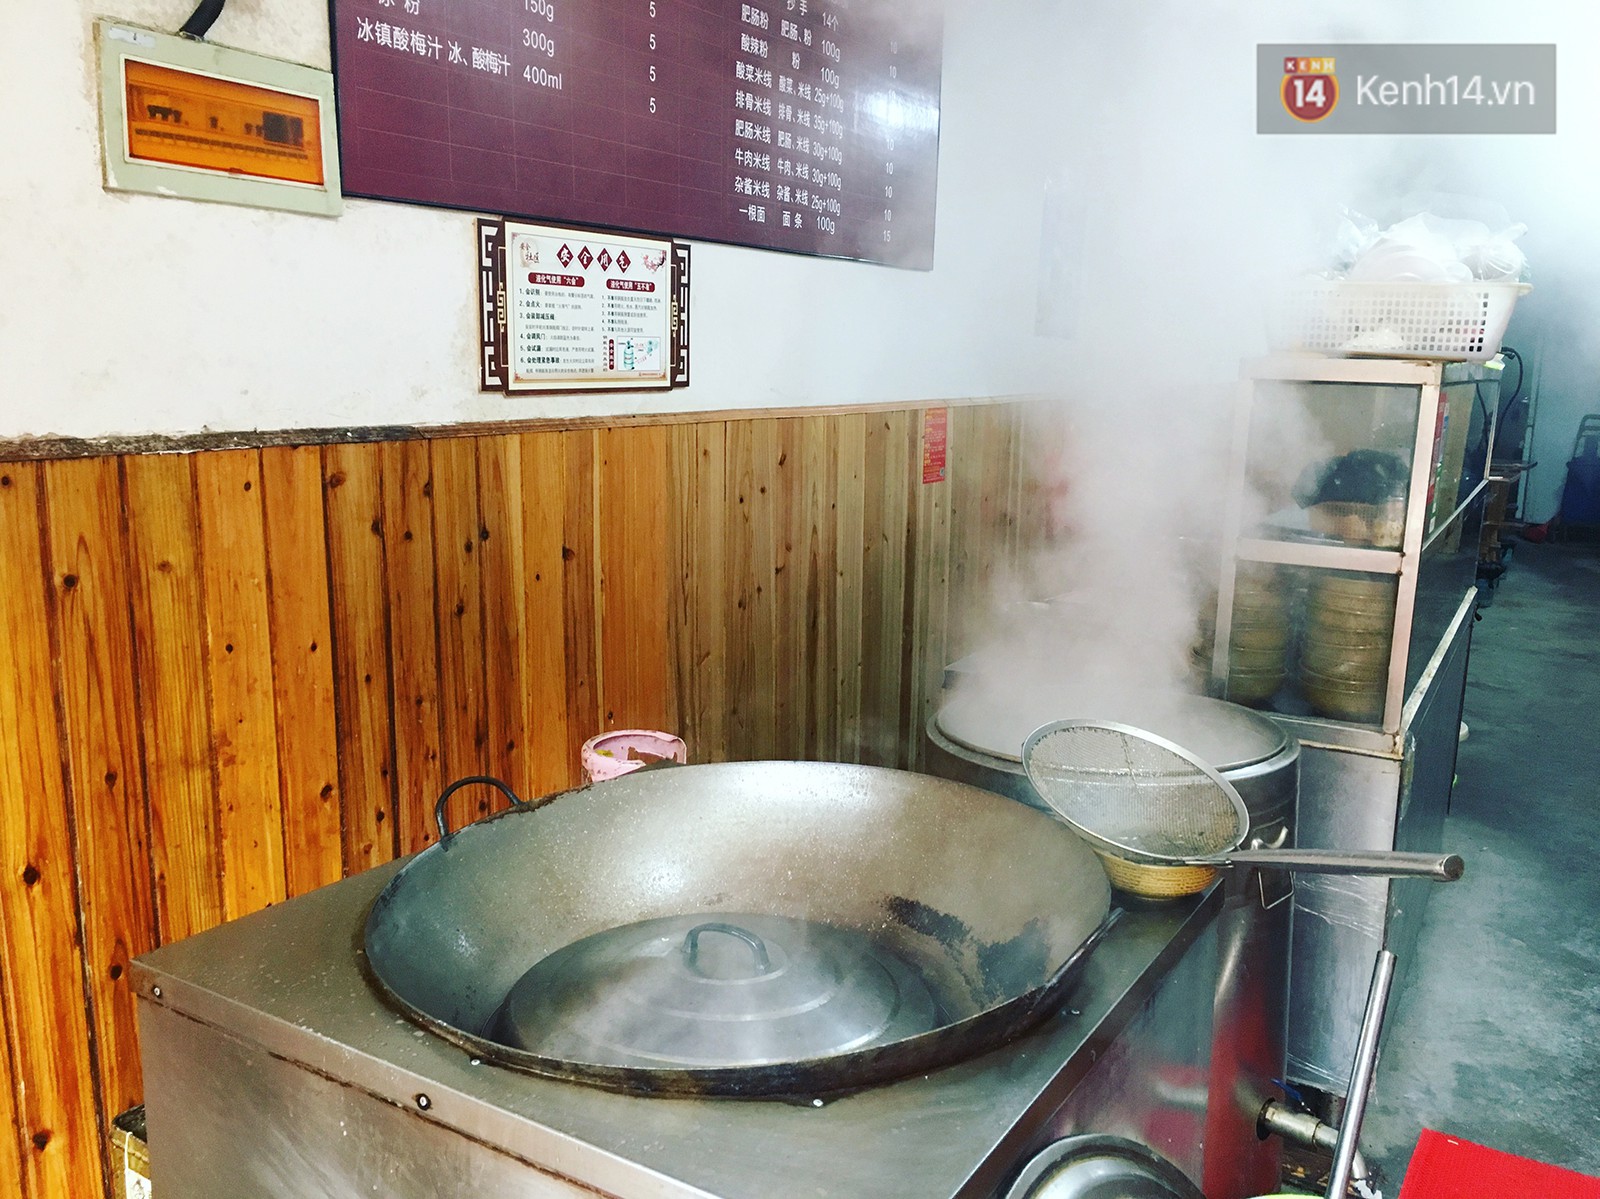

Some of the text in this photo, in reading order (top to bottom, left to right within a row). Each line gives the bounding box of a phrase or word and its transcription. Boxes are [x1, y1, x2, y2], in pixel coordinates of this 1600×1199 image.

[524, 0, 656, 49] 150g 5
[741, 3, 769, 30] 肥肠粉
[821, 39, 841, 62] 100g
[889, 65, 897, 79] 10
[356, 17, 443, 60] 冰镇酸梅汁
[522, 64, 563, 90] 400ml
[649, 97, 656, 113] 5
[522, 28, 554, 57] 300g
[649, 66, 656, 81] 5
[735, 60, 772, 88] 酸菜米线
[741, 33, 768, 58] 酸辣粉
[791, 51, 801, 69] 粉
[820, 67, 840, 89] 100g
[735, 89, 772, 117] 排骨米线
[734, 119, 771, 144] 肥肠米线
[886, 162, 894, 175] 10
[734, 147, 771, 172] 牛肉米线
[811, 168, 842, 191] 30g+100g
[885, 186, 893, 199] 10
[734, 175, 771, 199] 杂酱米线
[811, 194, 841, 216] 25g+100g
[884, 209, 892, 222] 10
[738, 204, 766, 223] 一根面
[816, 215, 836, 235] 100g
[883, 230, 891, 242] 15
